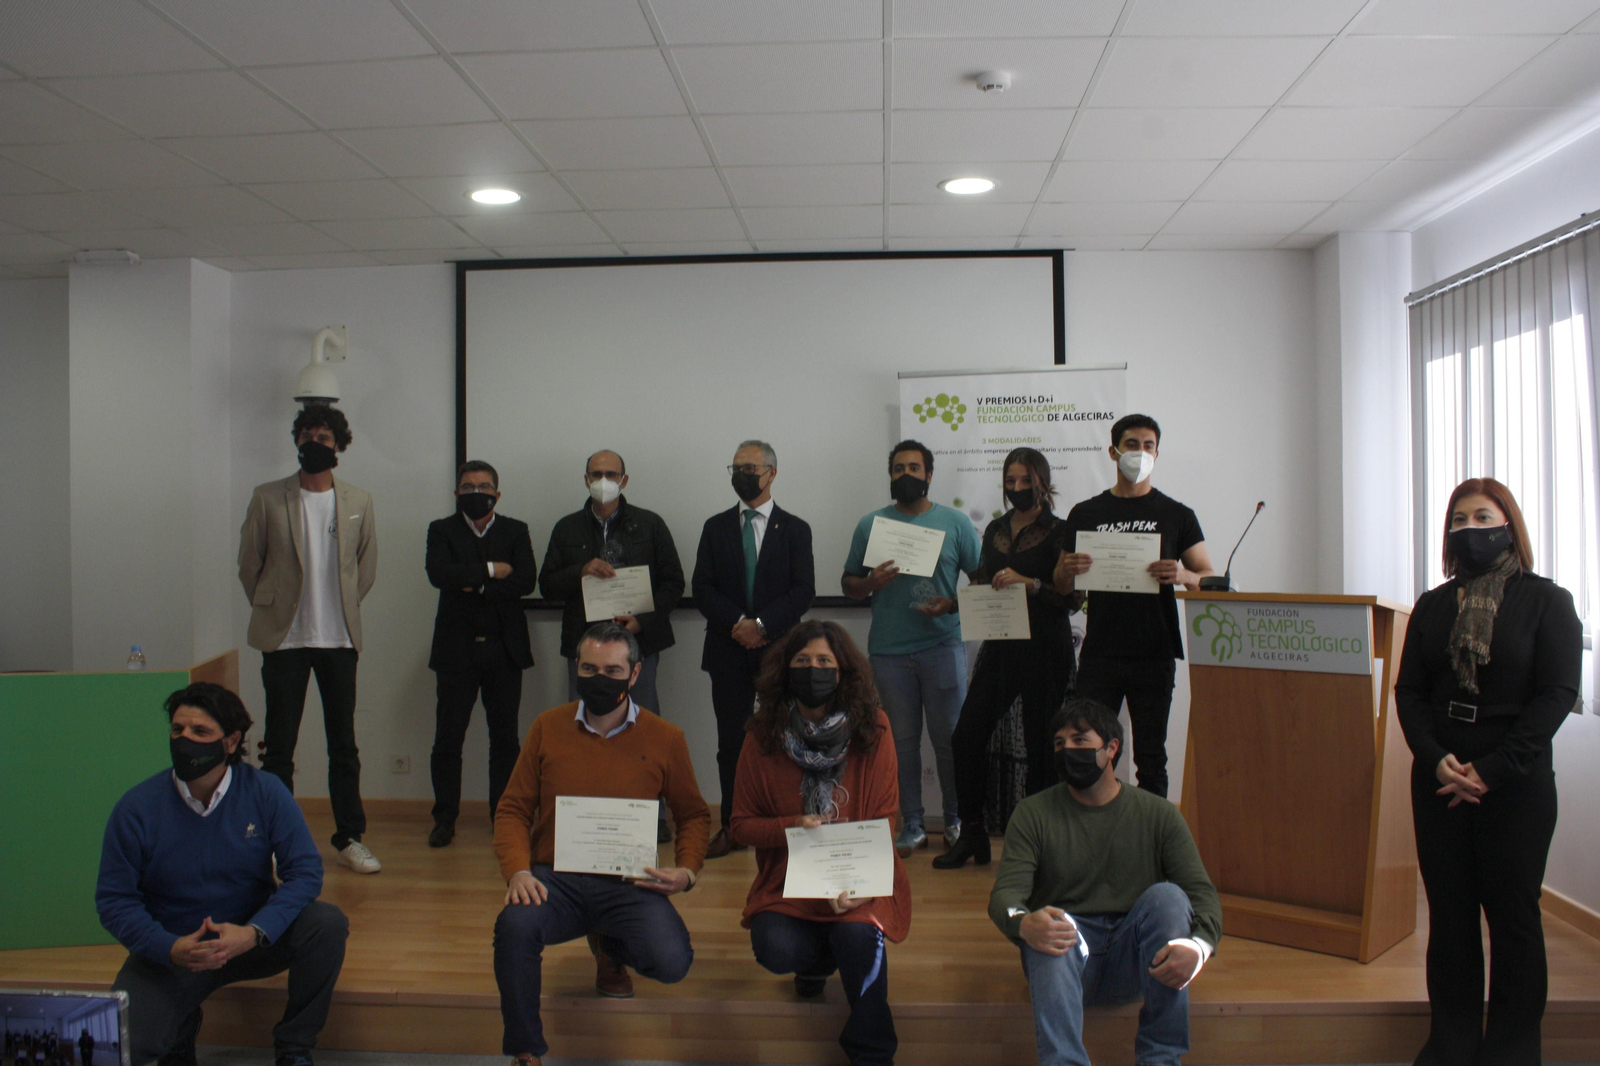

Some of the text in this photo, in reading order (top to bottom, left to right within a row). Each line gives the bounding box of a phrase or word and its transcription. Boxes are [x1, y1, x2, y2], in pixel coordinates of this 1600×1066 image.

[976, 397, 983, 406] V
[985, 396, 1027, 406] PREMIOS
[976, 403, 1076, 415] FUNDACIÓN CAMPUS
[976, 411, 1115, 424] TECNOLÓGICO DE ALGECIRAS
[988, 436, 1042, 445] MODALIDADES
[1095, 520, 1158, 533] TRASH PEAK
[1247, 607, 1300, 618] FUNDACIÓN
[1246, 617, 1316, 635] CAMPUS
[1247, 633, 1362, 654] TECNOLÓGICO
[1250, 651, 1310, 663] ALGECIRAS
